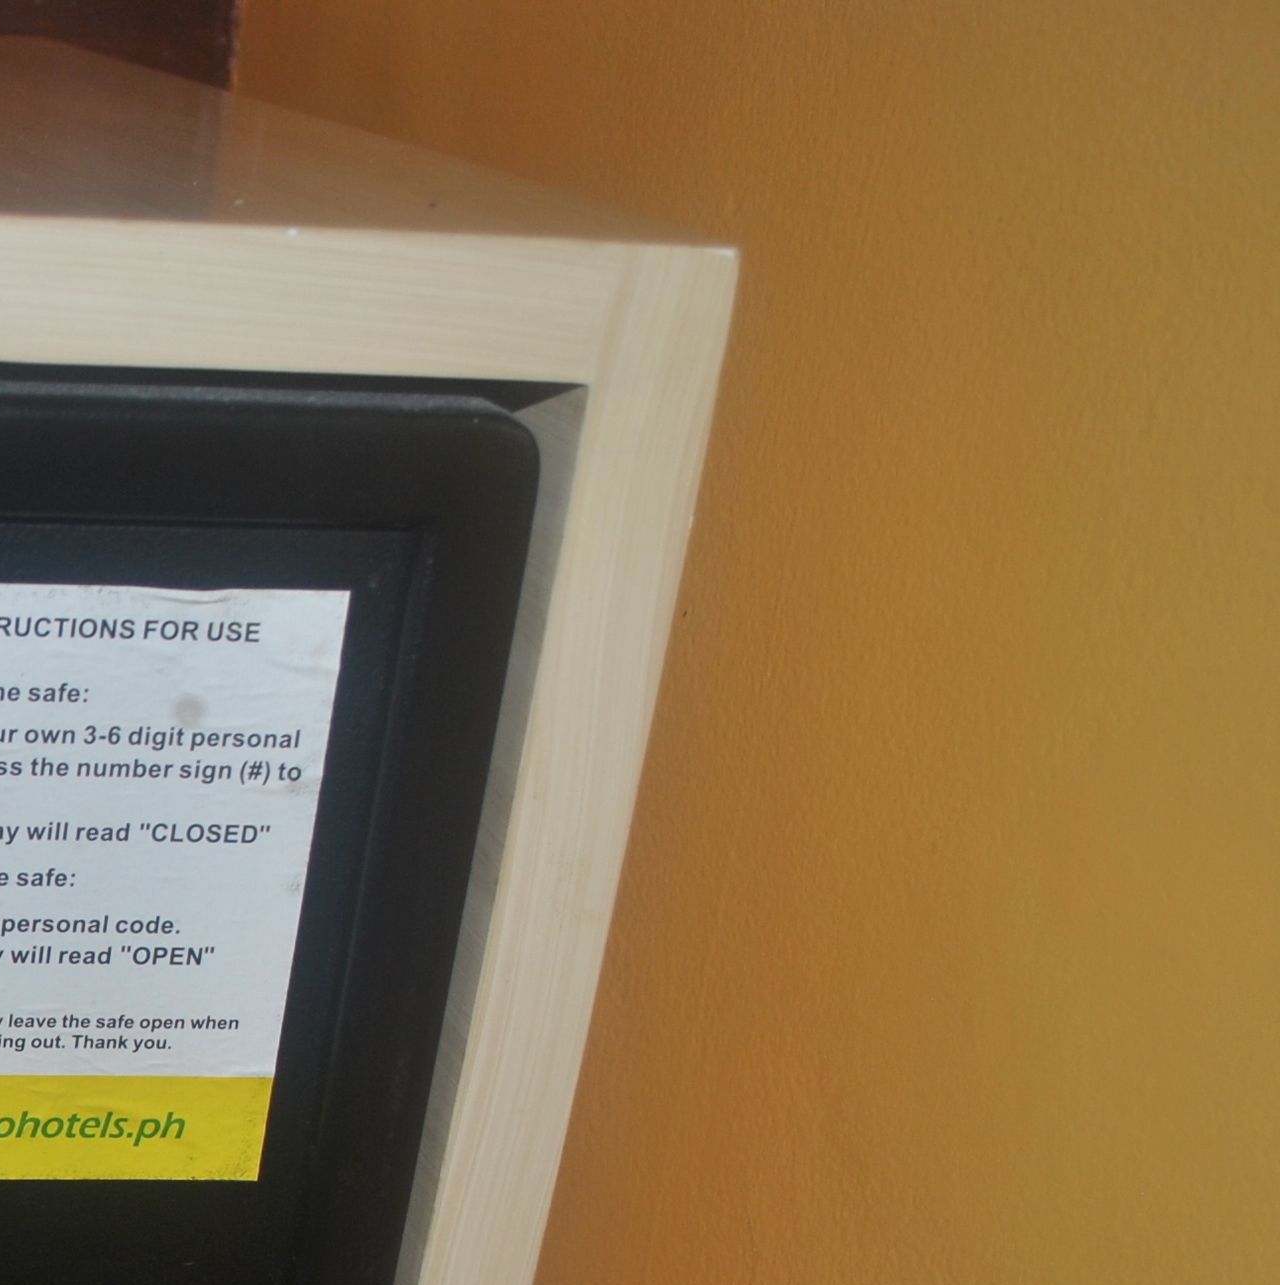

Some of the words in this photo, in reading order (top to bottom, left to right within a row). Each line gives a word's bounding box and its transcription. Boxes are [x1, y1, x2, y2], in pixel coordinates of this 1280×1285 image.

[143, 619, 199, 641] FOR
[207, 621, 261, 643] USE
[27, 682, 89, 703] safe:
[24, 728, 76, 745] own
[83, 725, 121, 745] 3-6
[128, 726, 185, 752] digit
[189, 729, 301, 752] personal
[30, 757, 70, 777] the
[76, 758, 174, 779] number
[179, 759, 232, 785] sign
[239, 760, 271, 786] (#)
[278, 762, 302, 783] to
[26, 821, 69, 841] will
[75, 822, 131, 842] read
[140, 822, 271, 844] "CLOSED"
[16, 867, 76, 888] safe:
[0, 914, 109, 937] personal
[115, 915, 180, 935] code.
[10, 945, 52, 965] will
[58, 946, 113, 965] read
[120, 945, 215, 966] "OPEN"
[8, 1013, 57, 1029] leave
[62, 1013, 91, 1029] the
[95, 1014, 135, 1030] safe
[139, 1018, 185, 1033] open
[190, 1015, 240, 1030] when
[30, 1035, 66, 1049] out.
[71, 1034, 129, 1050] Thank
[132, 1036, 172, 1053] you.
